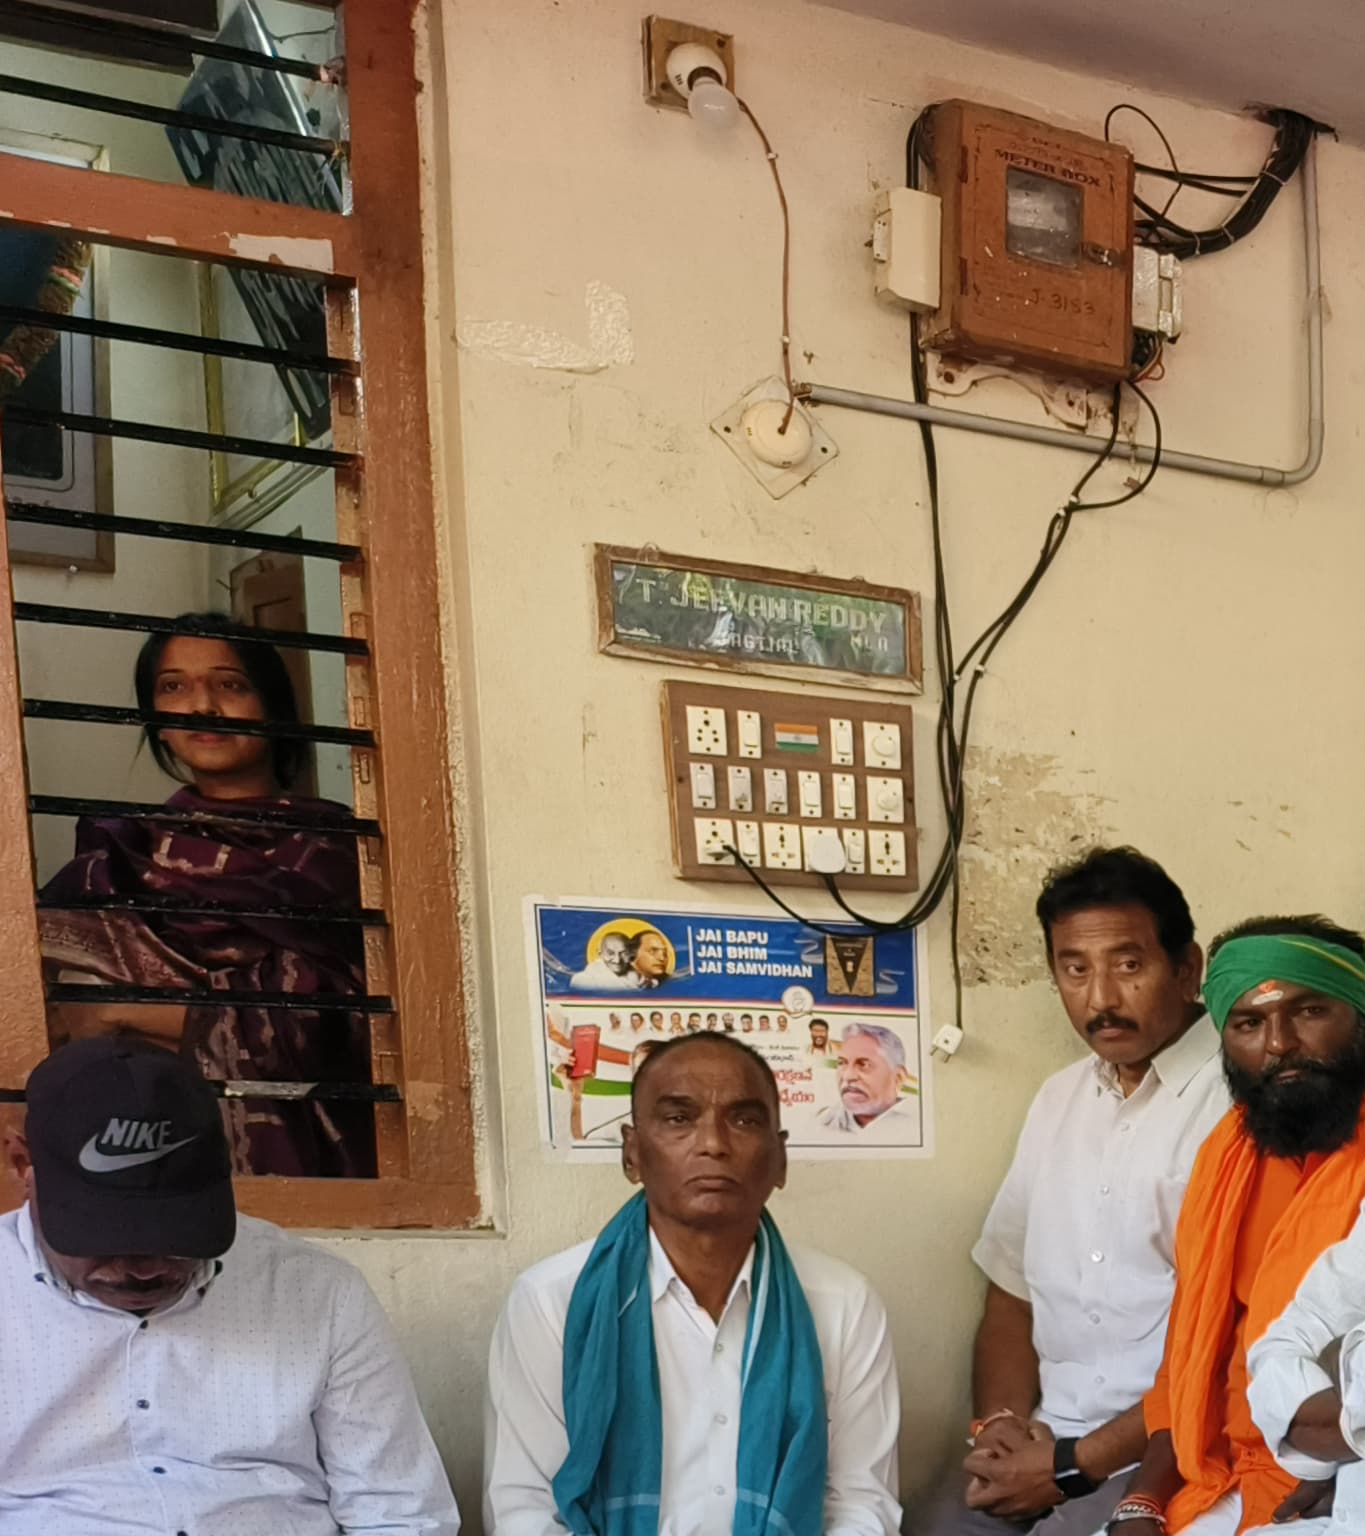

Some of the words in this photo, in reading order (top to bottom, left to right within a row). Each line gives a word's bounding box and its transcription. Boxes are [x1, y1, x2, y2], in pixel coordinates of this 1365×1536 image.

[696, 929, 722, 943] JAI
[726, 930, 768, 945] BAPU
[697, 945, 722, 959] JAI
[726, 946, 768, 960] BHIM
[697, 961, 723, 974] JAI
[726, 961, 813, 978] SAMVIDHAN
[100, 1117, 173, 1150] NIKE
